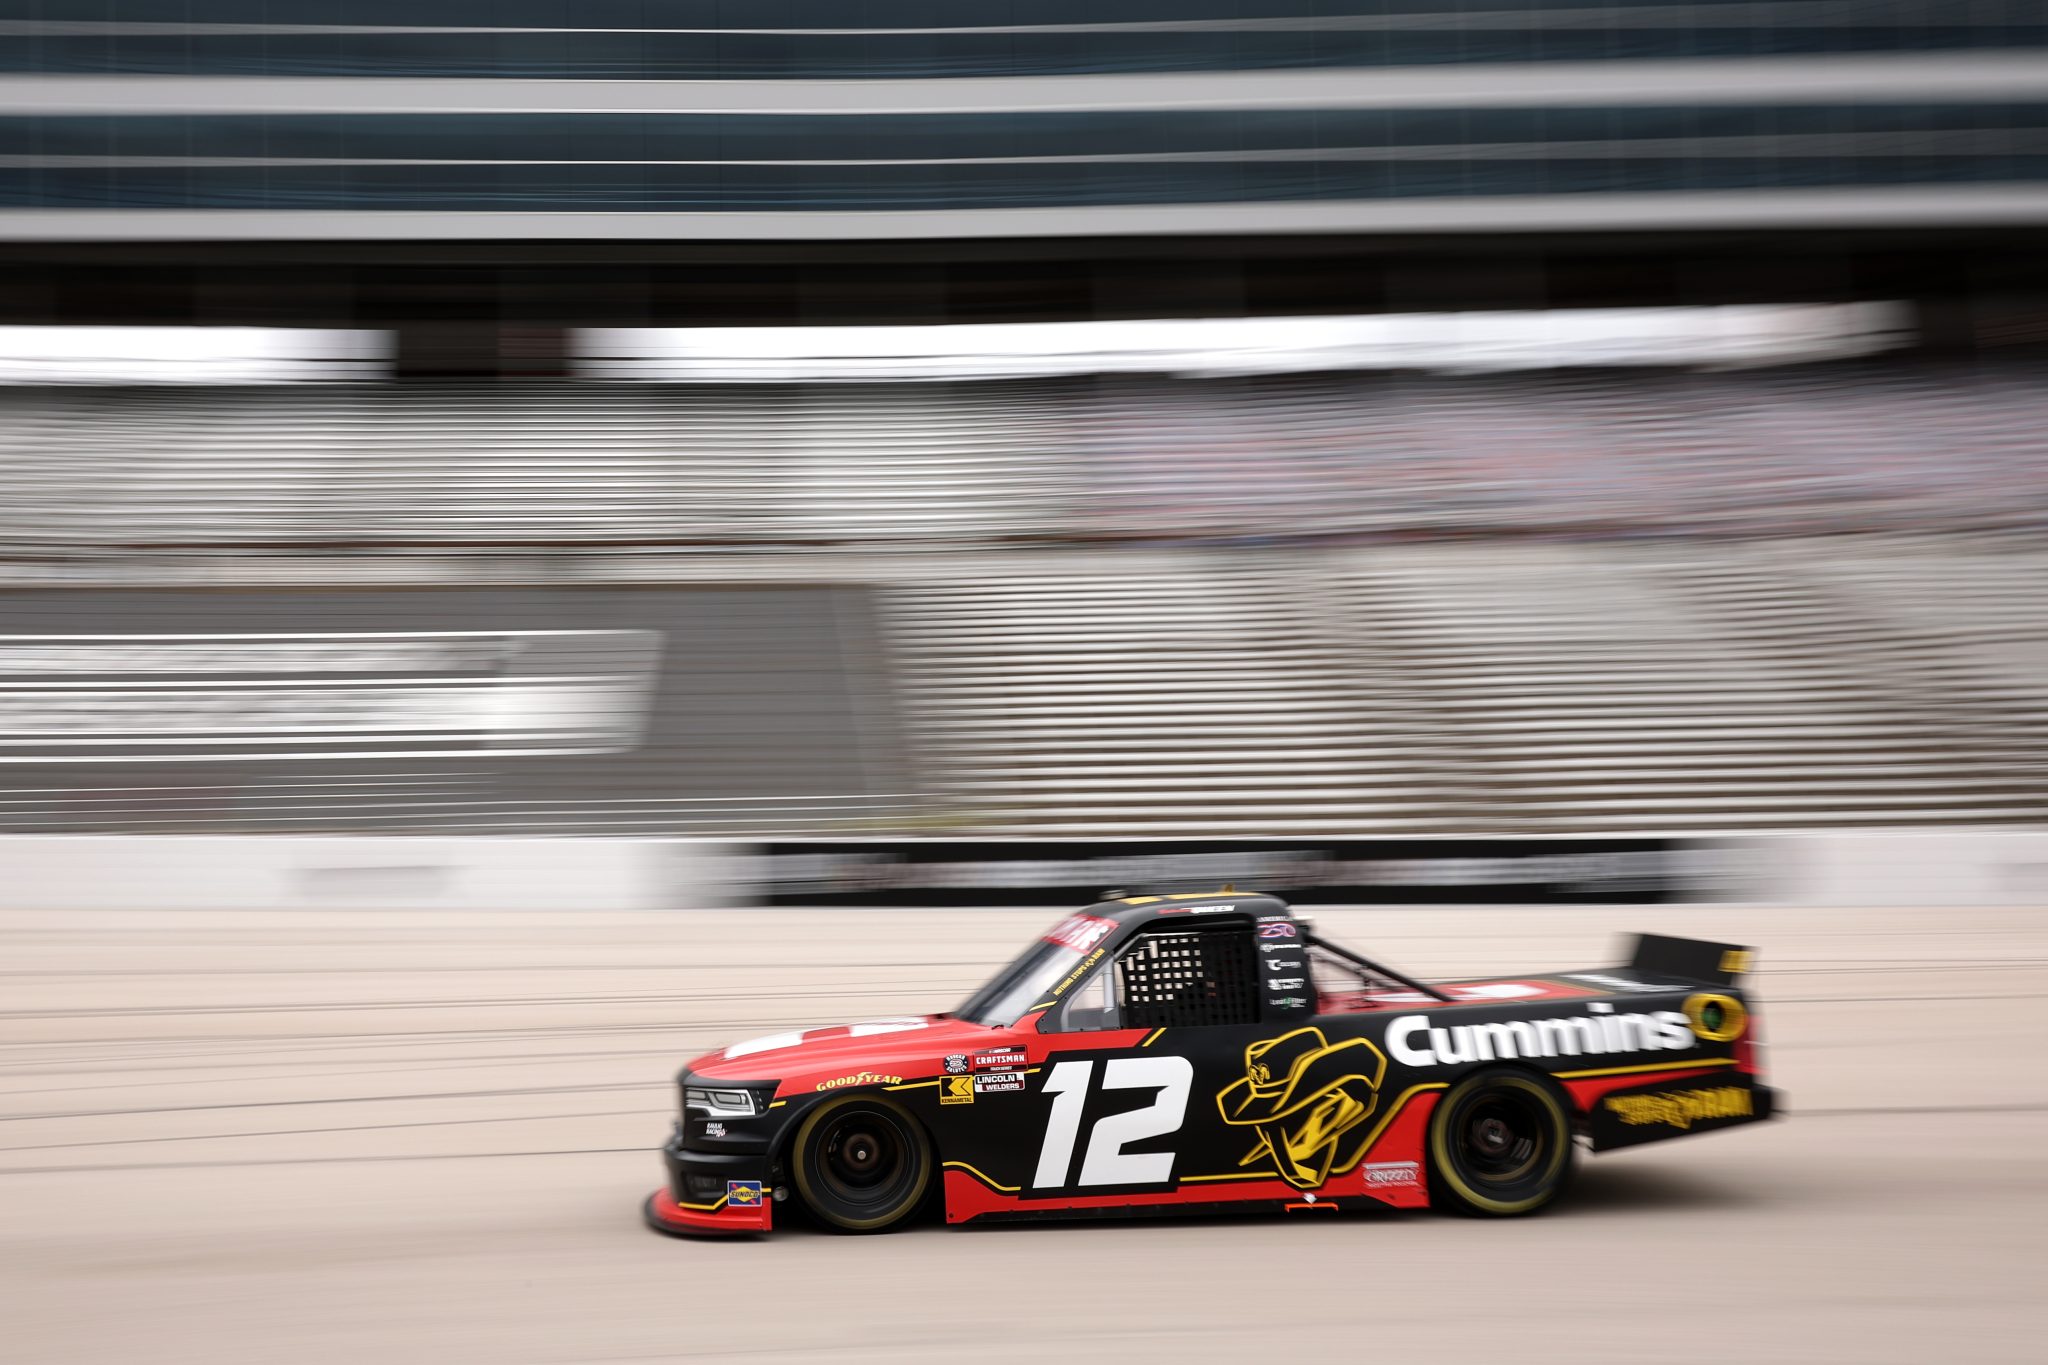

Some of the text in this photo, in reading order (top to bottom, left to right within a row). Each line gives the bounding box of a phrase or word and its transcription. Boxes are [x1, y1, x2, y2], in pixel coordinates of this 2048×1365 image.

[1384, 1002, 1696, 1067] Cummins
[976, 1054, 1025, 1065] CRAFTSMAN
[816, 1071, 903, 1092] GOODYEAR
[977, 1074, 1015, 1084] LINCOLN
[985, 1082, 1020, 1091] WELDERS
[1032, 1055, 1194, 1189] 12
[730, 1190, 760, 1198] SUNOCO
